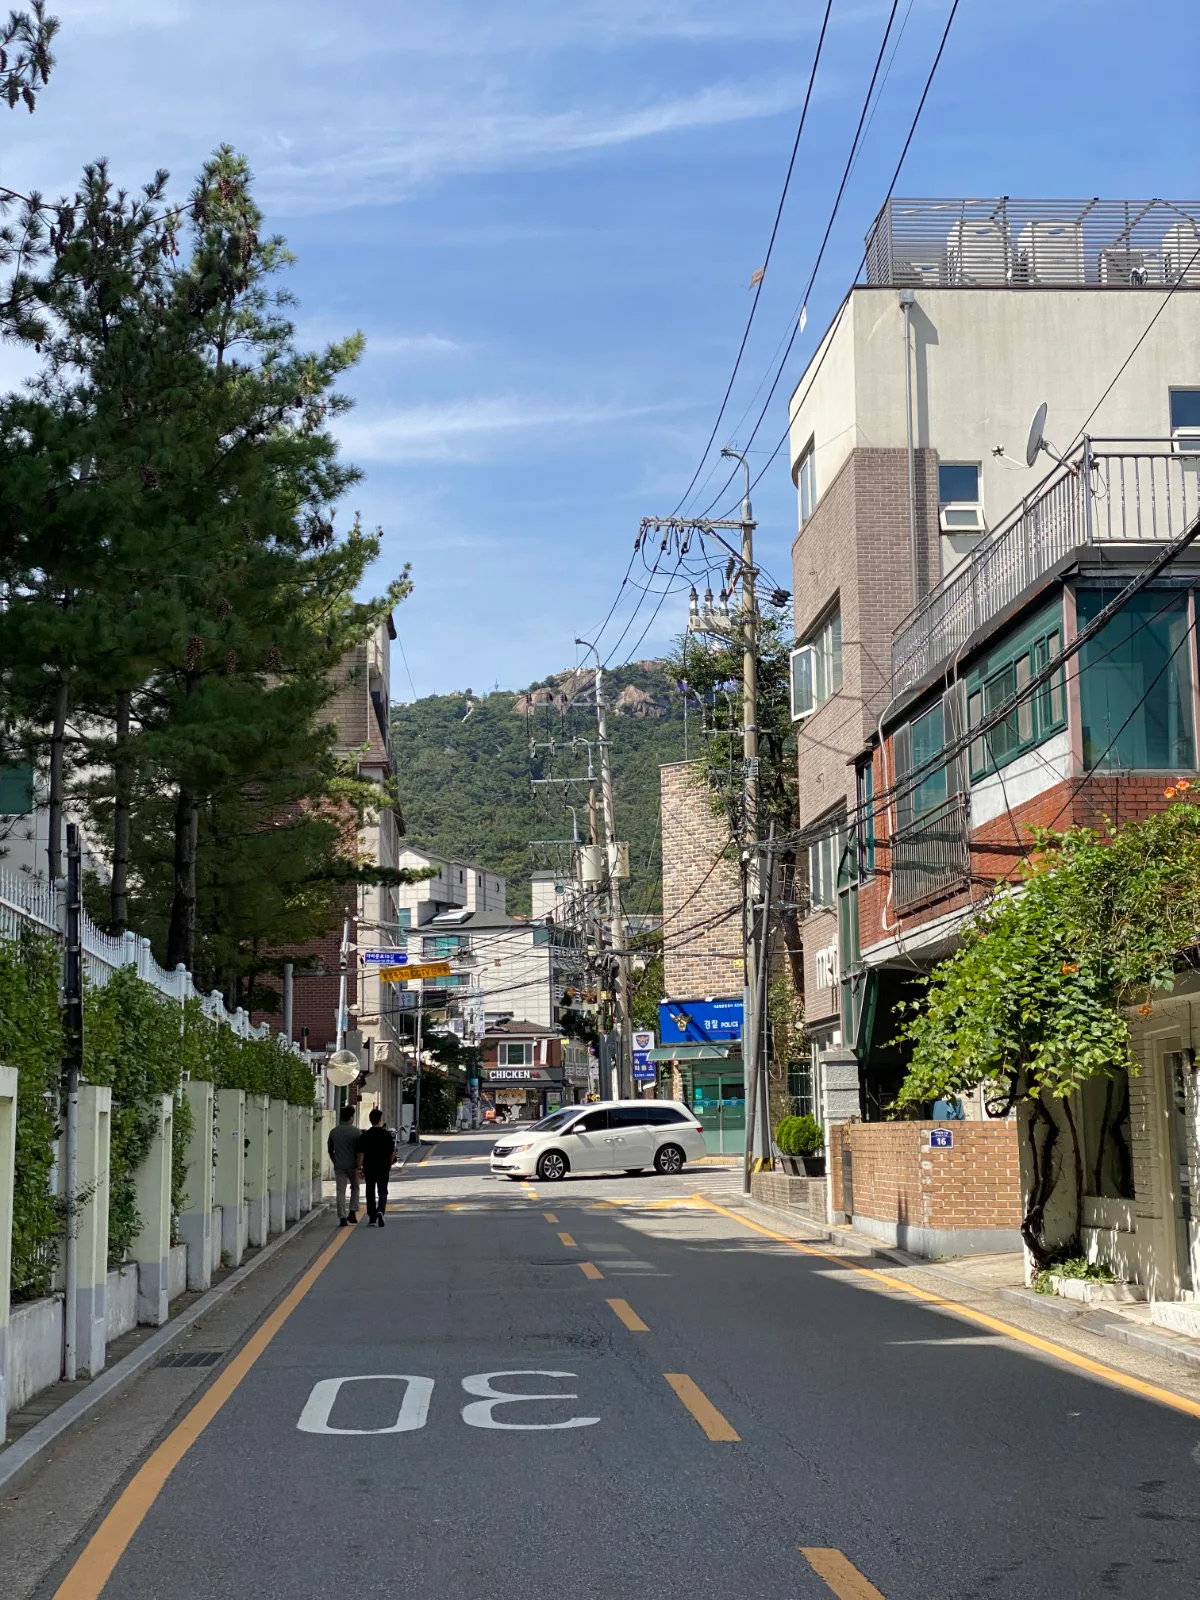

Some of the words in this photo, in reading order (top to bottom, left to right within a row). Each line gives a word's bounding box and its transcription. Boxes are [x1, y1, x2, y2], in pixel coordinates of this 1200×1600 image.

[411, 968, 430, 978] CCTV
[704, 1019, 718, 1030] 경찰
[490, 1070, 530, 1079] CHICKEN
[936, 1137, 947, 1146] 16
[296, 1370, 600, 1435] 30
